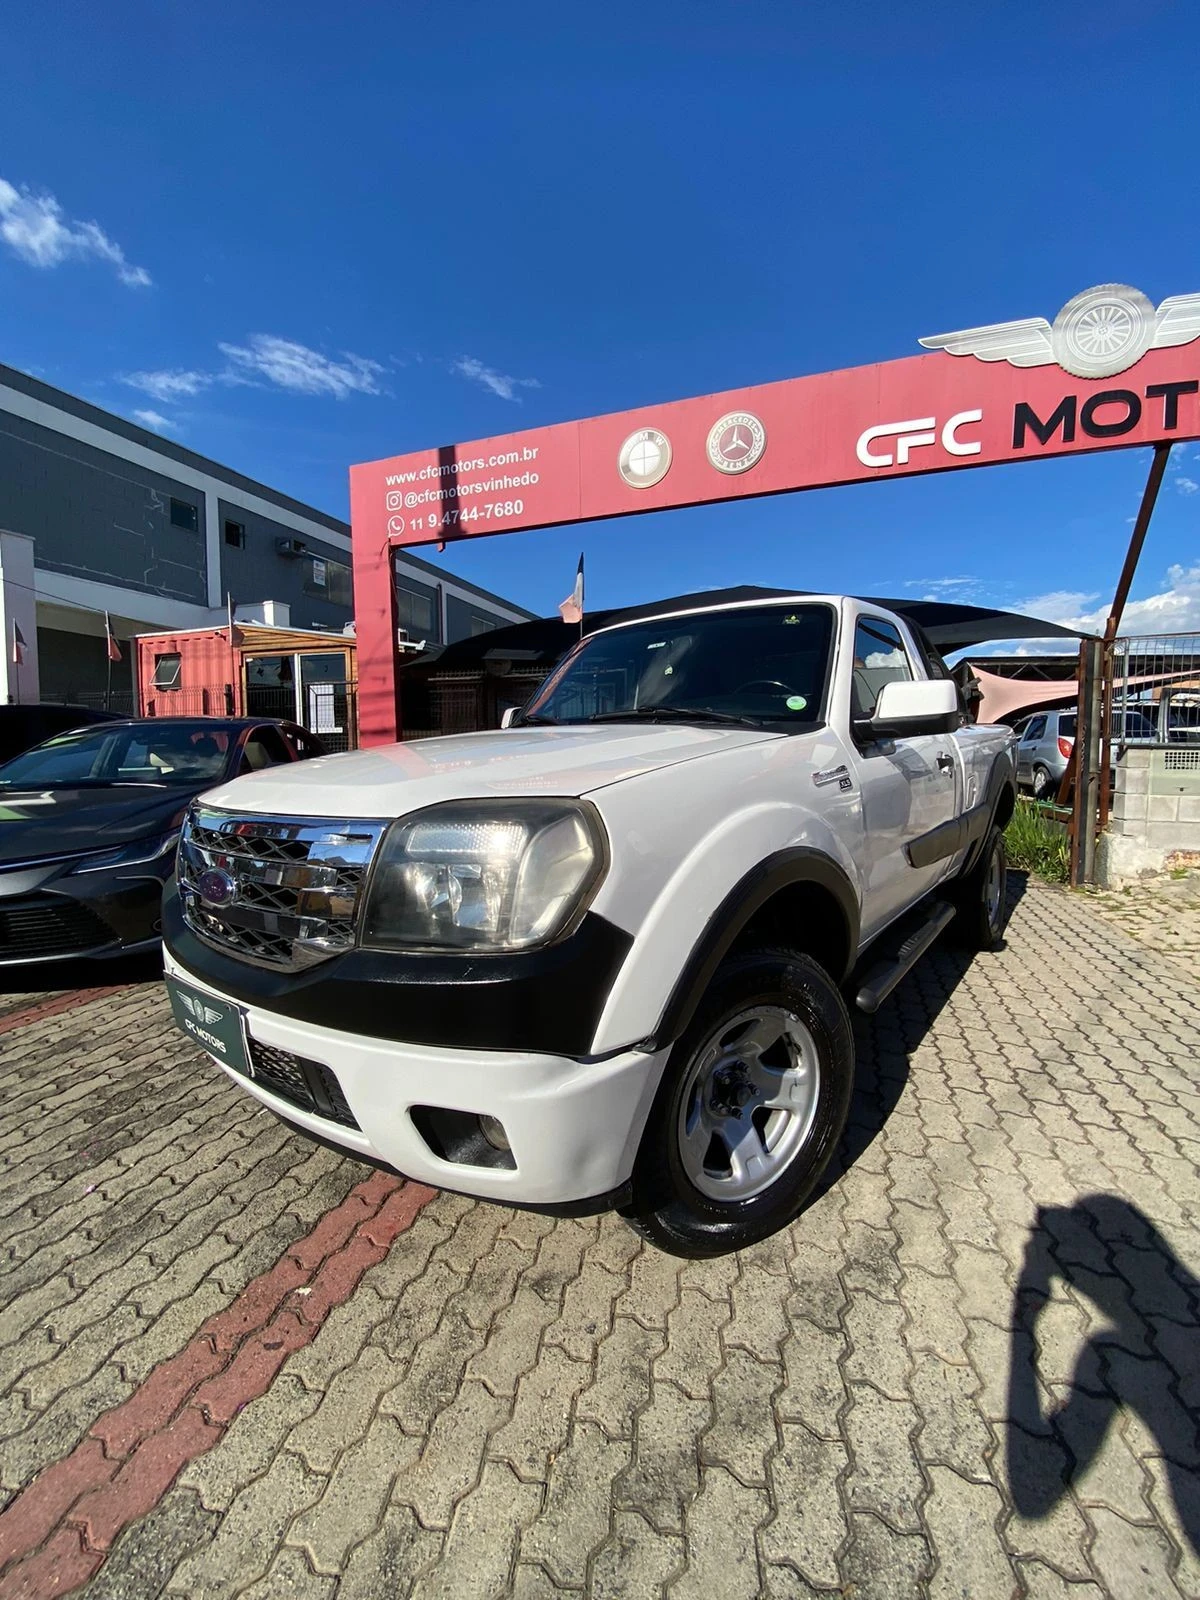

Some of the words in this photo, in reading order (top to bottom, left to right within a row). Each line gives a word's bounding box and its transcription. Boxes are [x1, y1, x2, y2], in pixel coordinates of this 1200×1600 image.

[717, 416, 758, 434] MERCEDES
[856, 408, 982, 467] CFC
[1012, 379, 1199, 449] MOT
[385, 446, 539, 486] www.cfcmotors.com.br
[723, 458, 752, 469] BENZ
[404, 471, 539, 508] @cfcmotorsvinhedo
[410, 517, 423, 531] 11
[427, 499, 524, 528] 9.4744-7680
[196, 1025, 227, 1053] MOTORS
